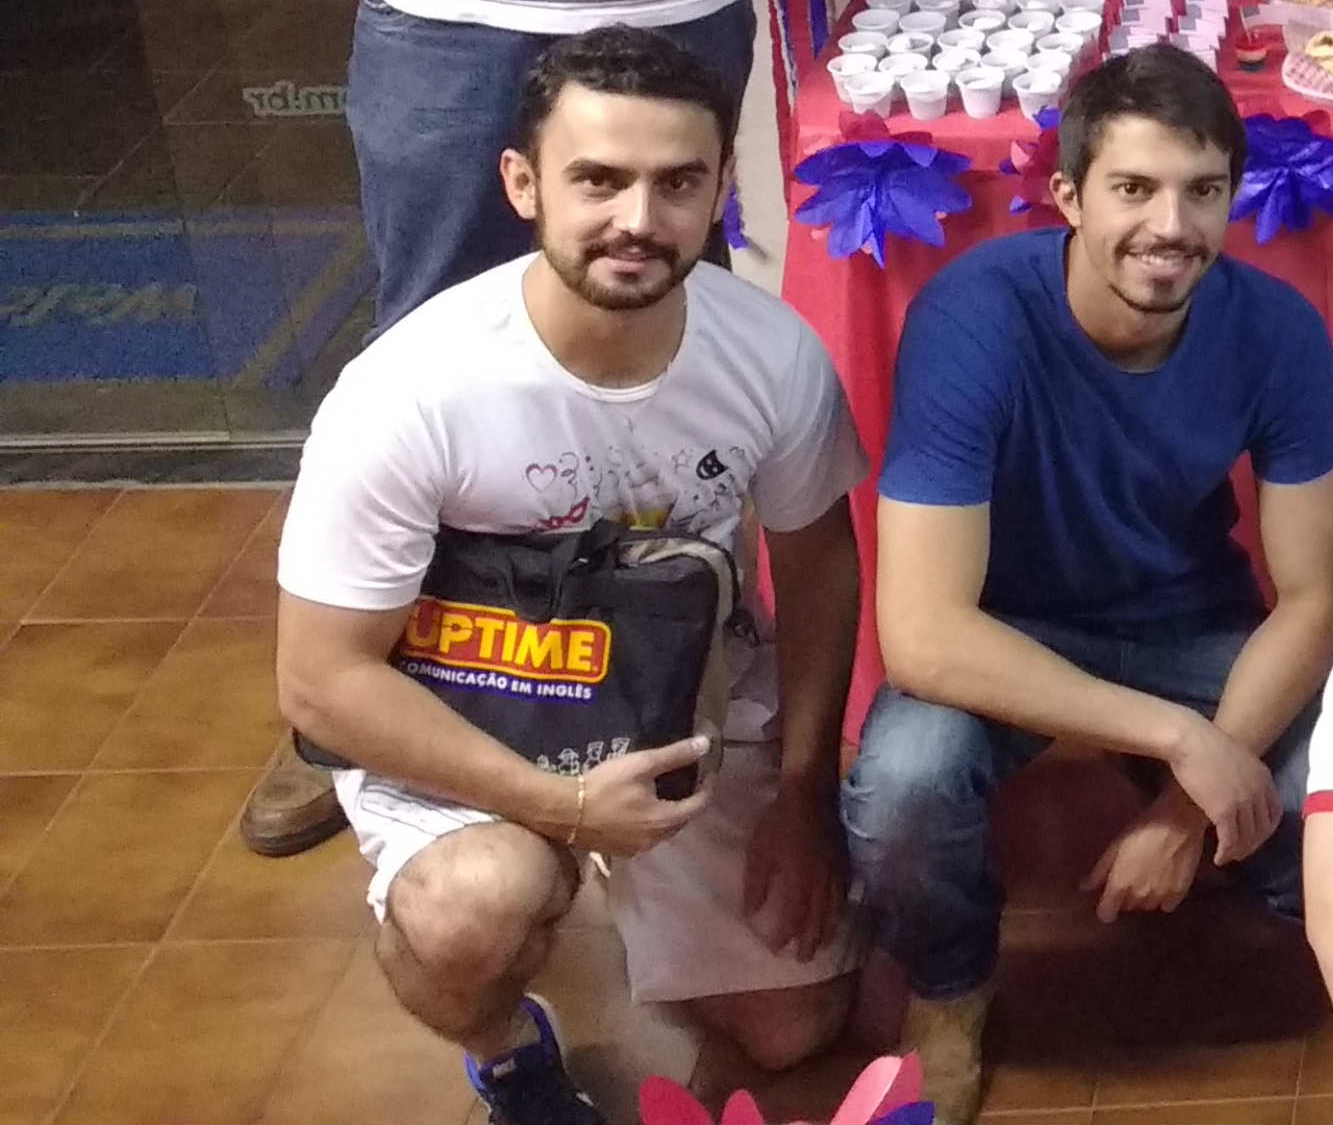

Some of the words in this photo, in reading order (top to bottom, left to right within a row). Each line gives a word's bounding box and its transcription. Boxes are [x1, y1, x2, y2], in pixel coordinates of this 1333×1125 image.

[406, 605, 596, 672] UPTIME
[400, 660, 508, 690] OMUNICAÇÃO
[511, 680, 533, 695] EM
[536, 683, 592, 700] INGLÊS
